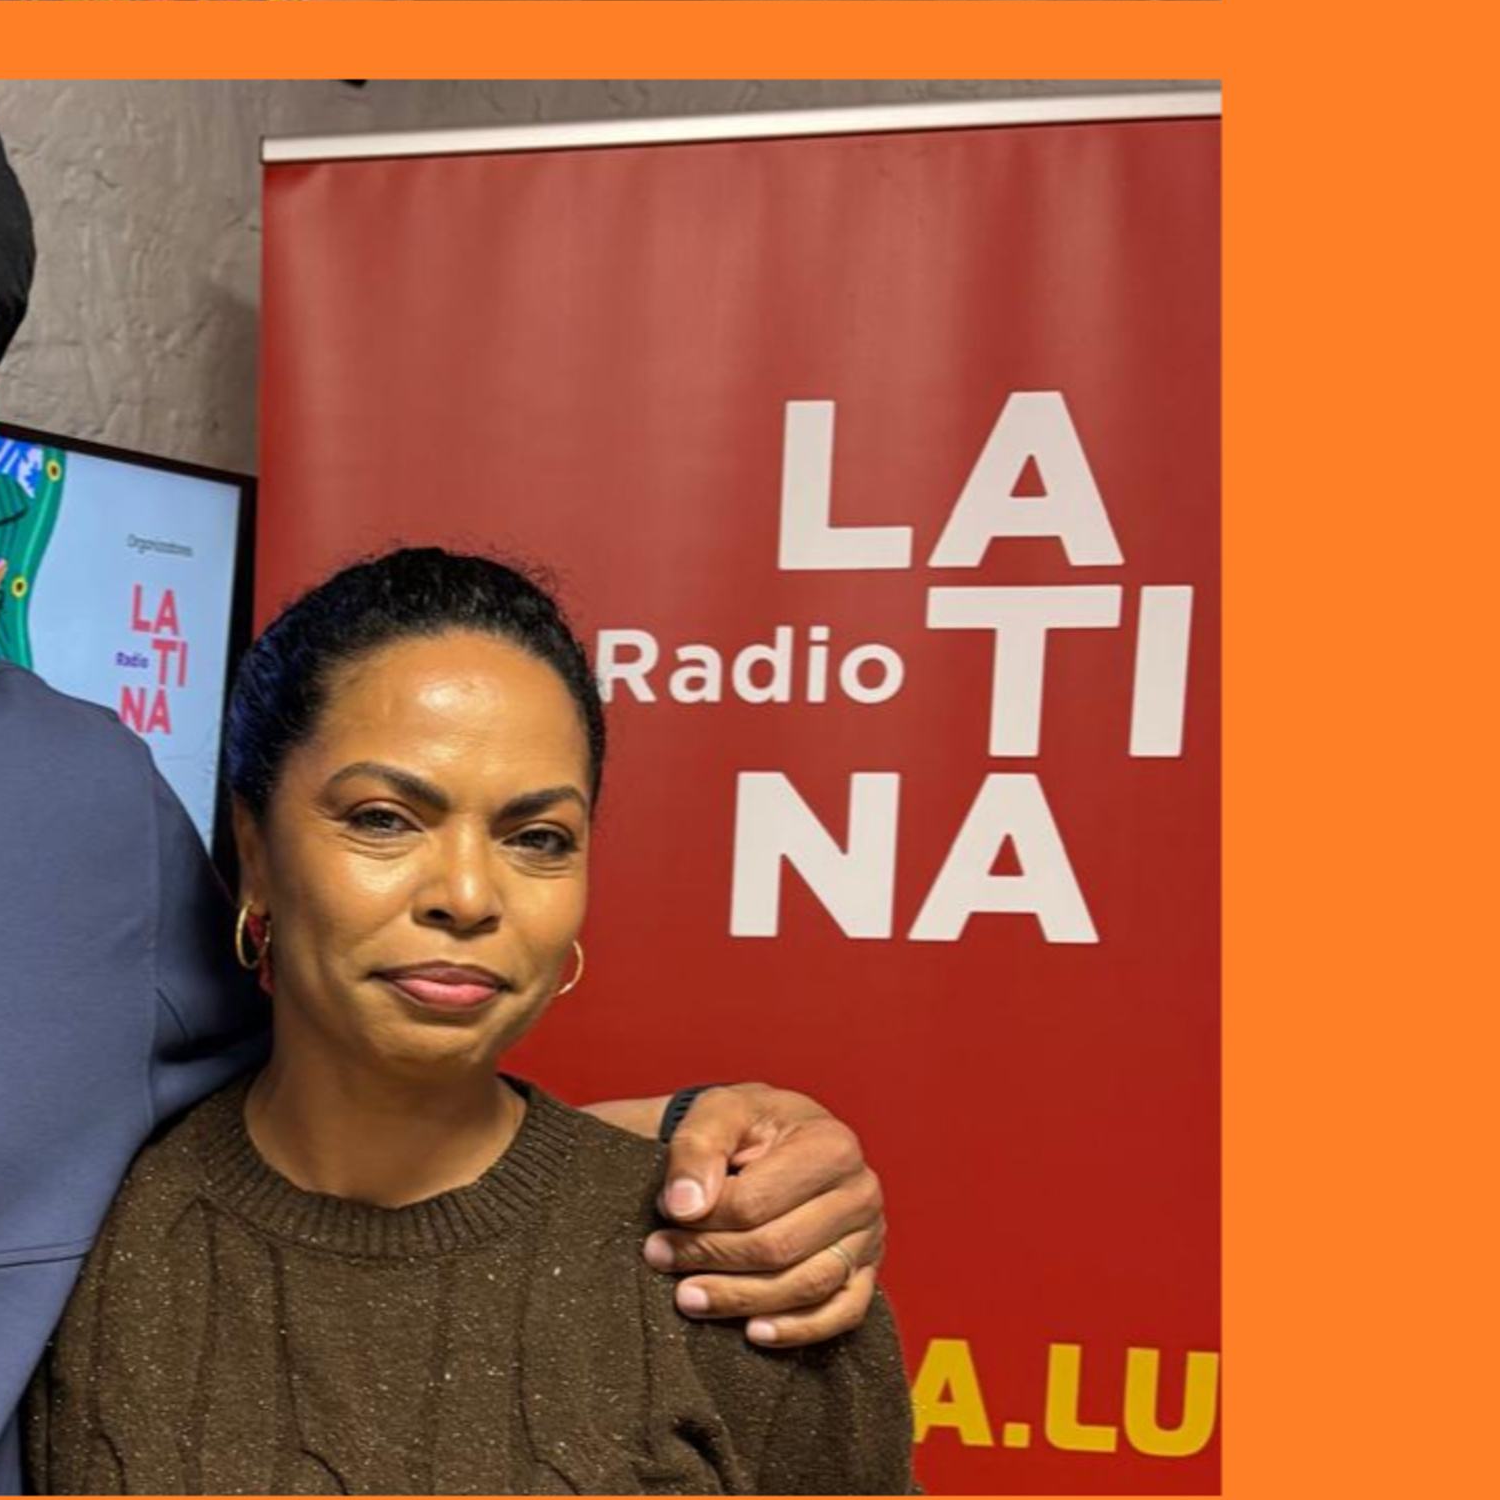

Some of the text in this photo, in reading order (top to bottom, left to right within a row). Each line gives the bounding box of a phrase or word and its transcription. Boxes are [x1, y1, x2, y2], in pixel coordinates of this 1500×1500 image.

[778, 391, 1125, 570] LA
[130, 583, 181, 636] LA
[151, 638, 188, 687] TI
[121, 685, 172, 734] NA
[596, 585, 1193, 758] Radio TI
[730, 771, 1100, 943] NA
[911, 1338, 1220, 1457] A.LU
